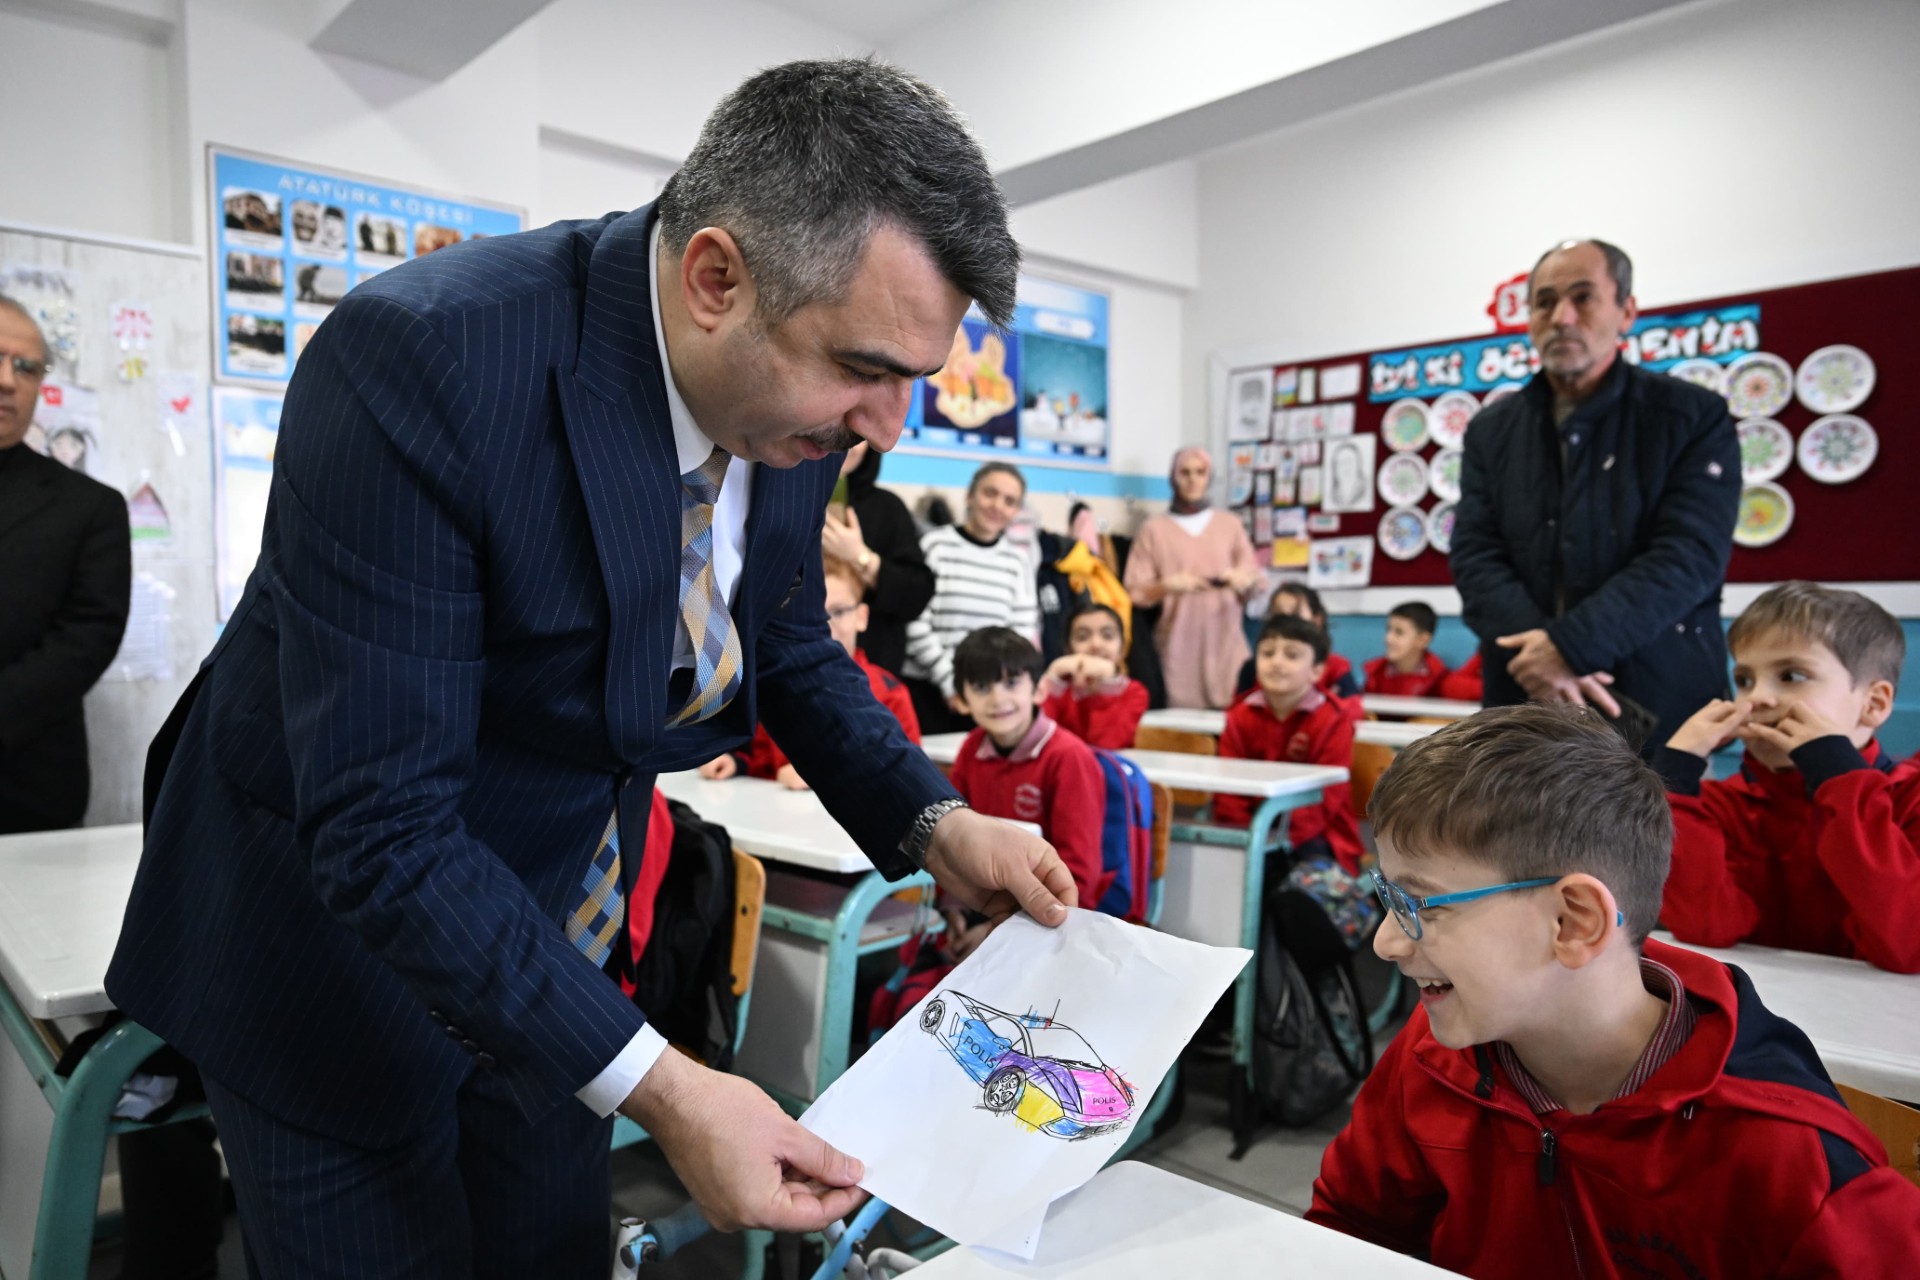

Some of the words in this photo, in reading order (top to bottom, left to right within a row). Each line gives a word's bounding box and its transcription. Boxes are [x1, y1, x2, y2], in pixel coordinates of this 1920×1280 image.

[279, 174, 381, 207] ATATÜRK
[963, 1036, 997, 1069] POLIS
[1092, 1096, 1117, 1105] POLIS
